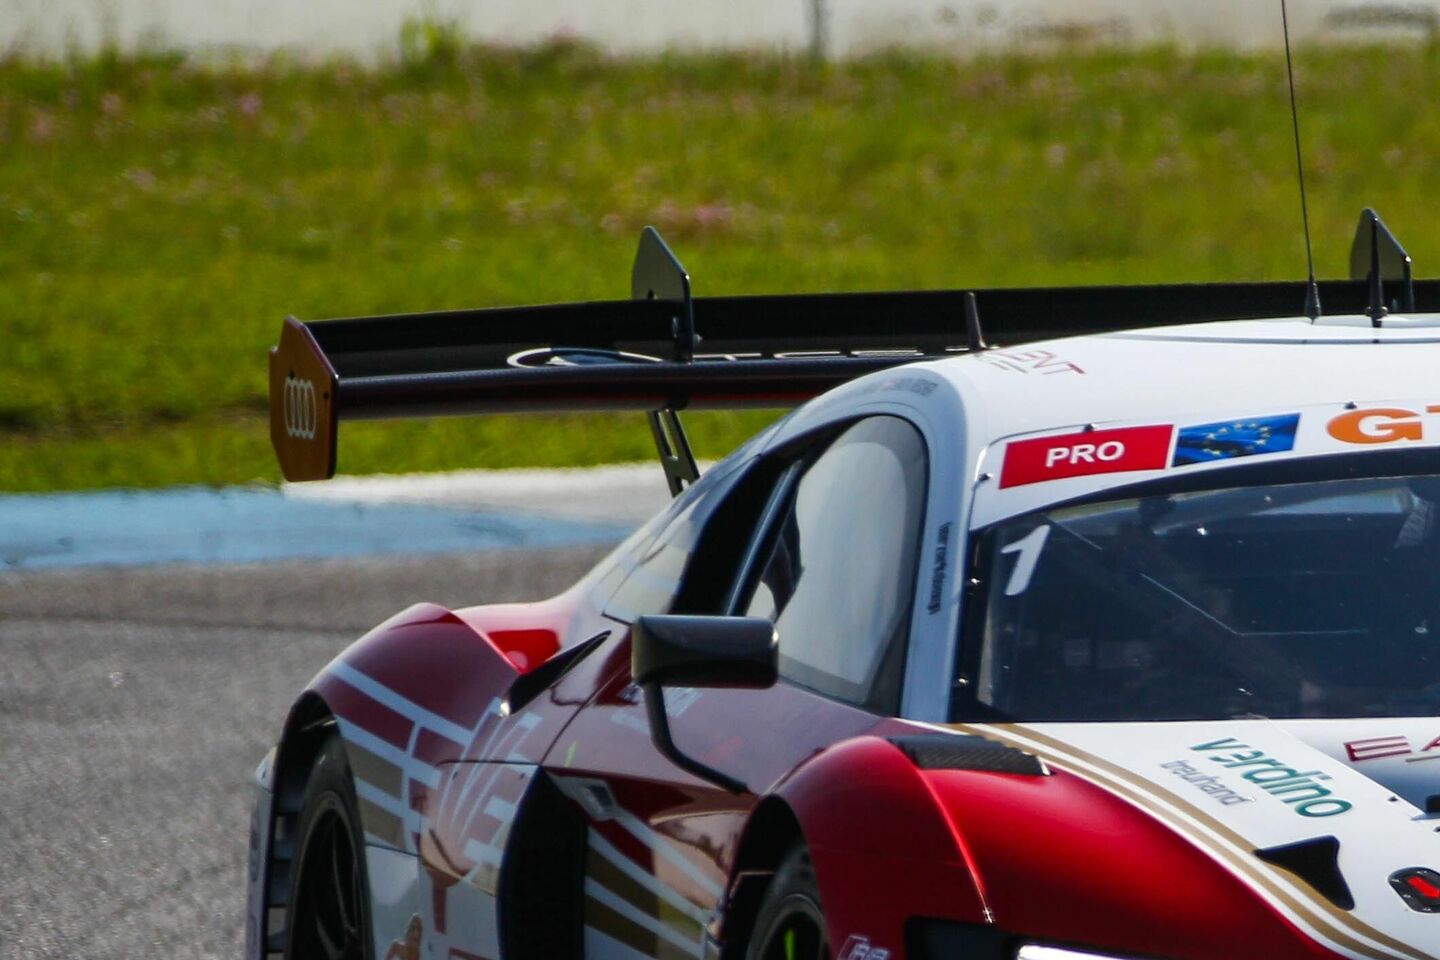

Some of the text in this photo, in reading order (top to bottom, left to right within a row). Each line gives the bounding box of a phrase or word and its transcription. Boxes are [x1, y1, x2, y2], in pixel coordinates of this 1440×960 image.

[1045, 439, 1126, 468] PRO
[1001, 524, 1051, 596] 1
[1159, 759, 1249, 809] treuhand
